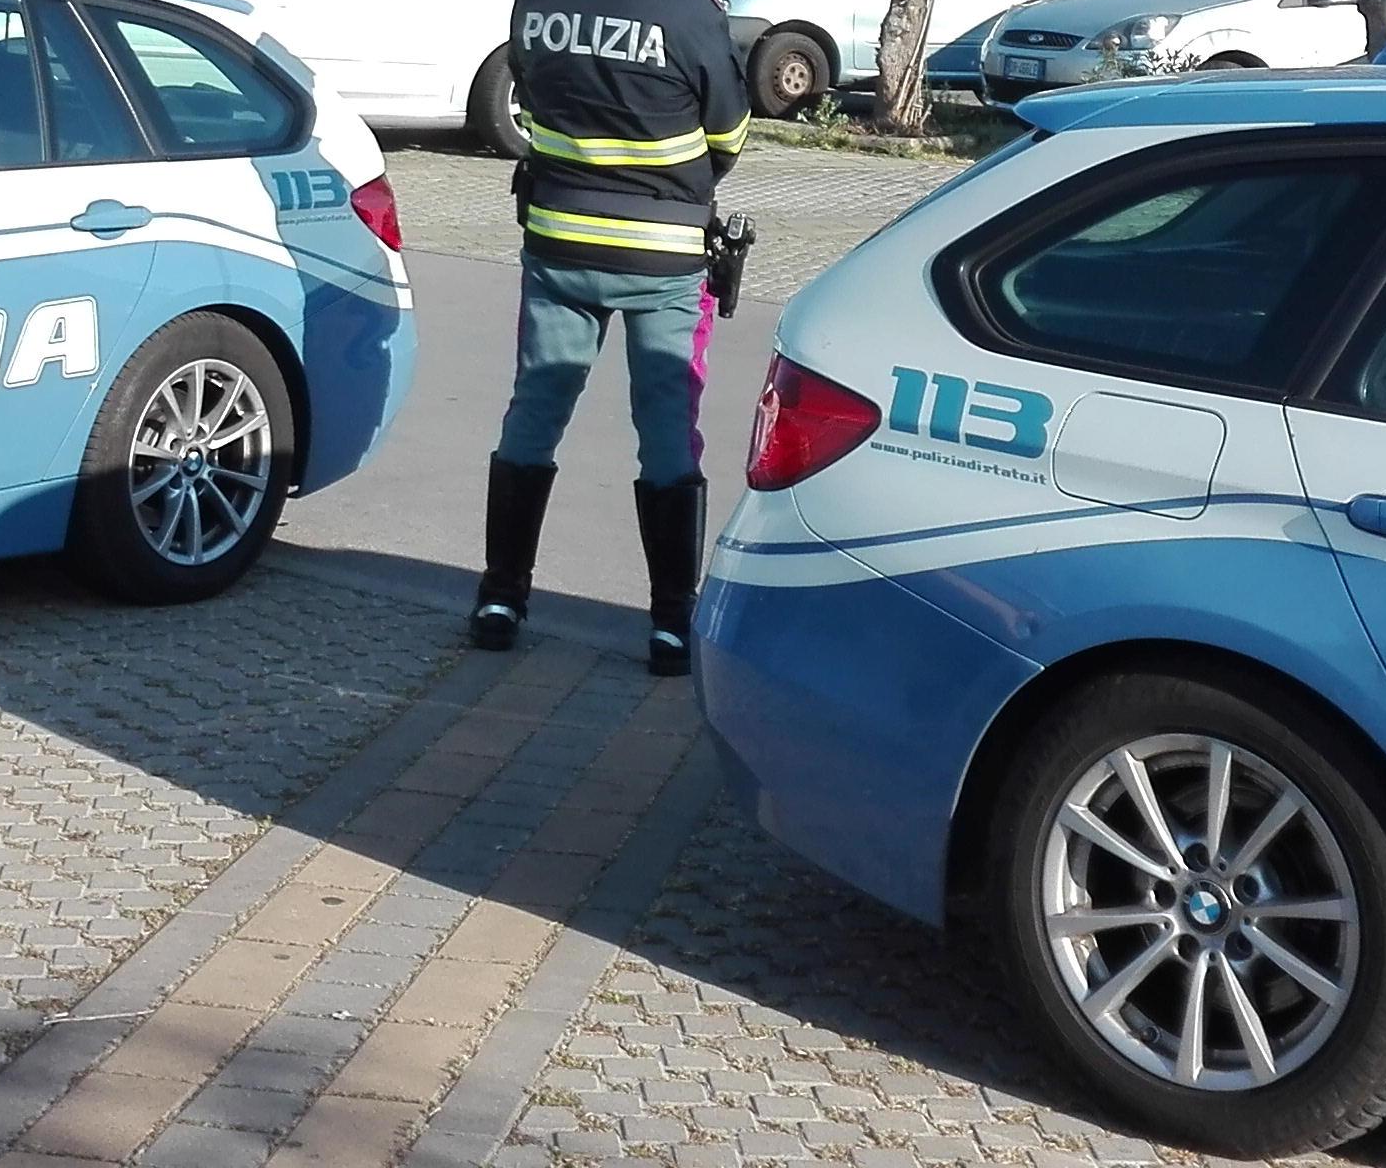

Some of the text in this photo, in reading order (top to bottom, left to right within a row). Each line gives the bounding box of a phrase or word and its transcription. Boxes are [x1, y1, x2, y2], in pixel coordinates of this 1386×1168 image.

[522, 11, 668, 69] POLIZIA
[271, 169, 348, 211] 113
[889, 365, 1055, 459] 113
[870, 440, 1048, 486] www.poliziadistato.it
